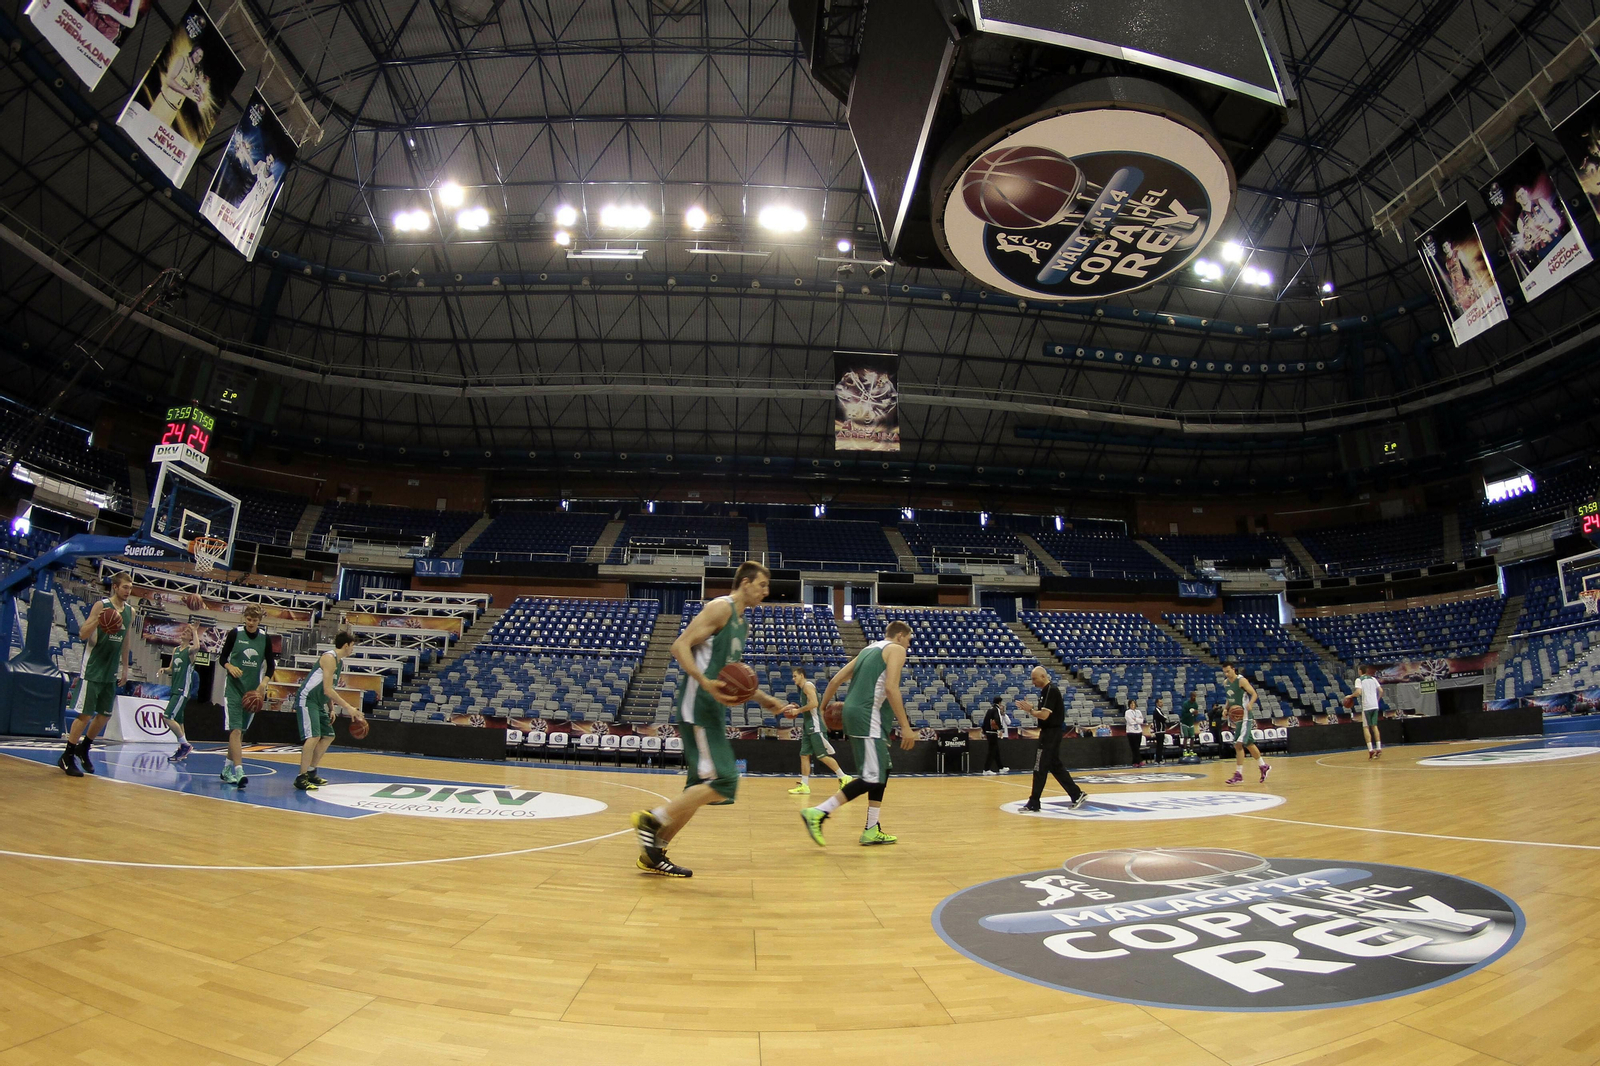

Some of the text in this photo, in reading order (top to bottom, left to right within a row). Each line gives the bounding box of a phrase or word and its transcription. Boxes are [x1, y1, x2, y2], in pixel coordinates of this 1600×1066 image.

[54, 14, 111, 67] SHERMADINI
[153, 131, 188, 162] NEWLEY
[1131, 188, 1168, 218] DEL
[1051, 189, 1130, 272] MÁLAA'14
[1111, 198, 1200, 279] REY
[1069, 225, 1145, 286] COPA
[166, 406, 192, 421] 57:59
[192, 407, 215, 431] 57:59
[161, 422, 186, 446] 24
[186, 424, 210, 453] 24
[157, 446, 180, 456] DKV
[185, 448, 206, 465] DKV
[1578, 501, 1598, 516] 57:59
[1583, 513, 1600, 533] 24
[123, 544, 165, 557] Suertia.es
[141, 710, 168, 729] KIA
[369, 783, 544, 806] DKV
[349, 800, 442, 814] SEGUROS
[1051, 877, 1331, 927] MÁLAGA'14
[1320, 883, 1413, 906] DEL
[1043, 902, 1338, 960] COPA
[1172, 895, 1491, 993] REY
